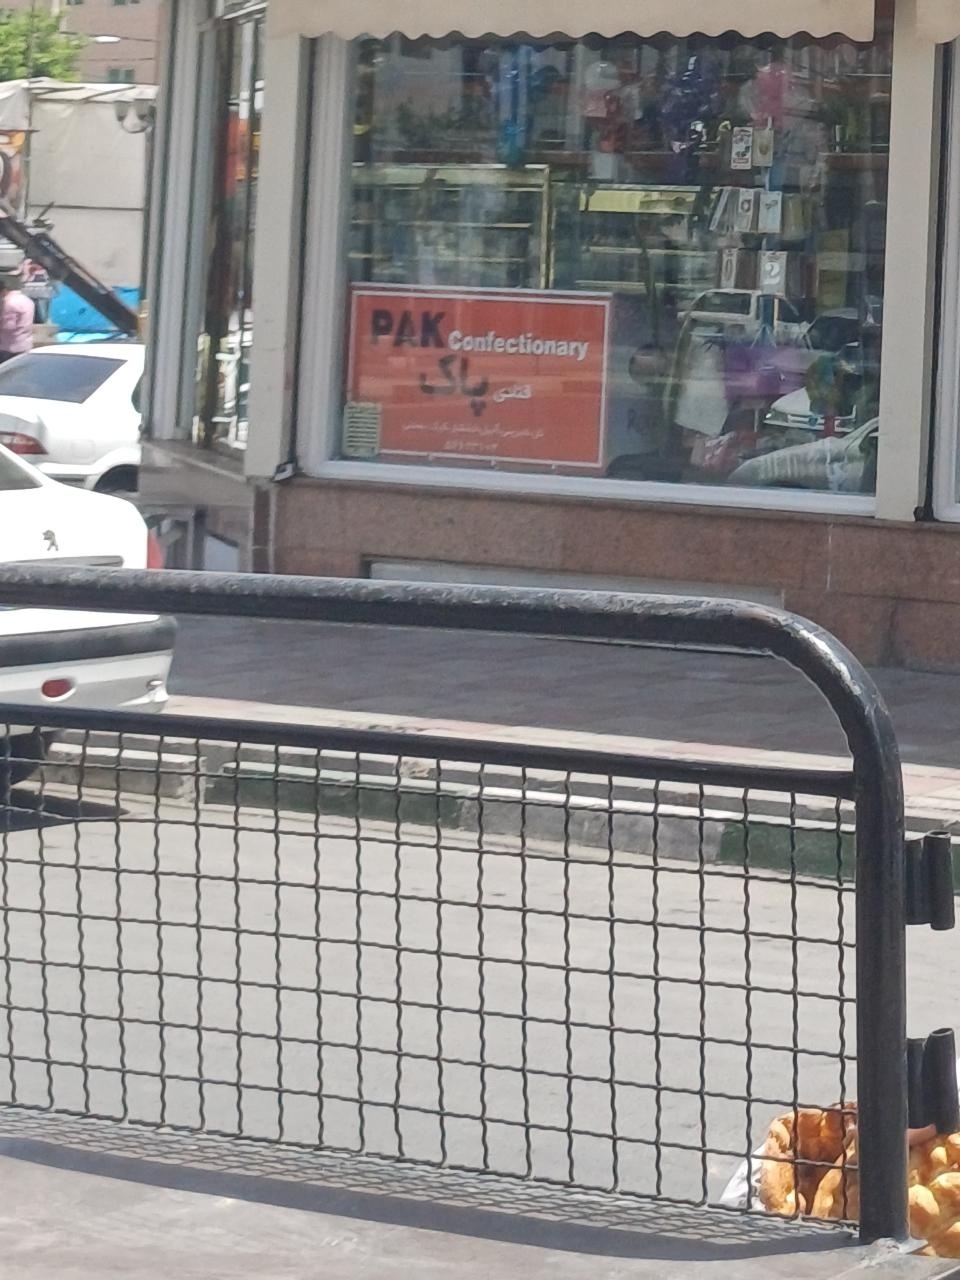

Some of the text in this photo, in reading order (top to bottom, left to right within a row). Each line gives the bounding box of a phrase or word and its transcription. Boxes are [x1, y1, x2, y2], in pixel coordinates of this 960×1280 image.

[370, 308, 589, 362] PAK Confectionary
[418, 354, 489, 418] پاک
